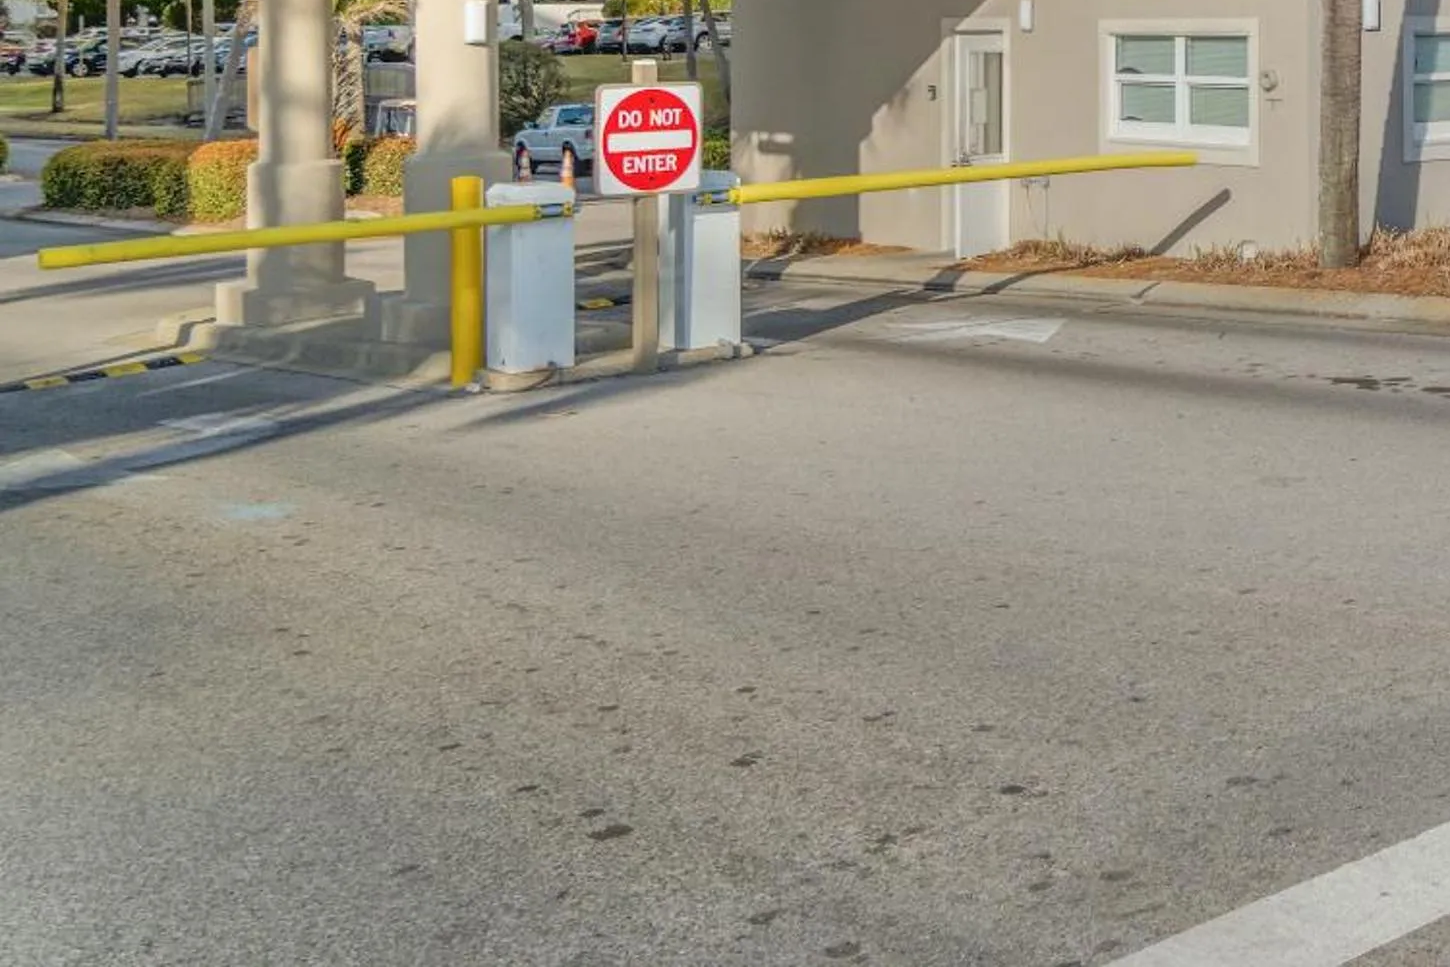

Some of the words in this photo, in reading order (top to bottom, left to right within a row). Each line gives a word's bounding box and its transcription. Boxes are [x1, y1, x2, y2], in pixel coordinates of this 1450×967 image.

[618, 109, 642, 128] DO
[649, 108, 682, 126] NOT
[622, 154, 677, 174] ENTER
